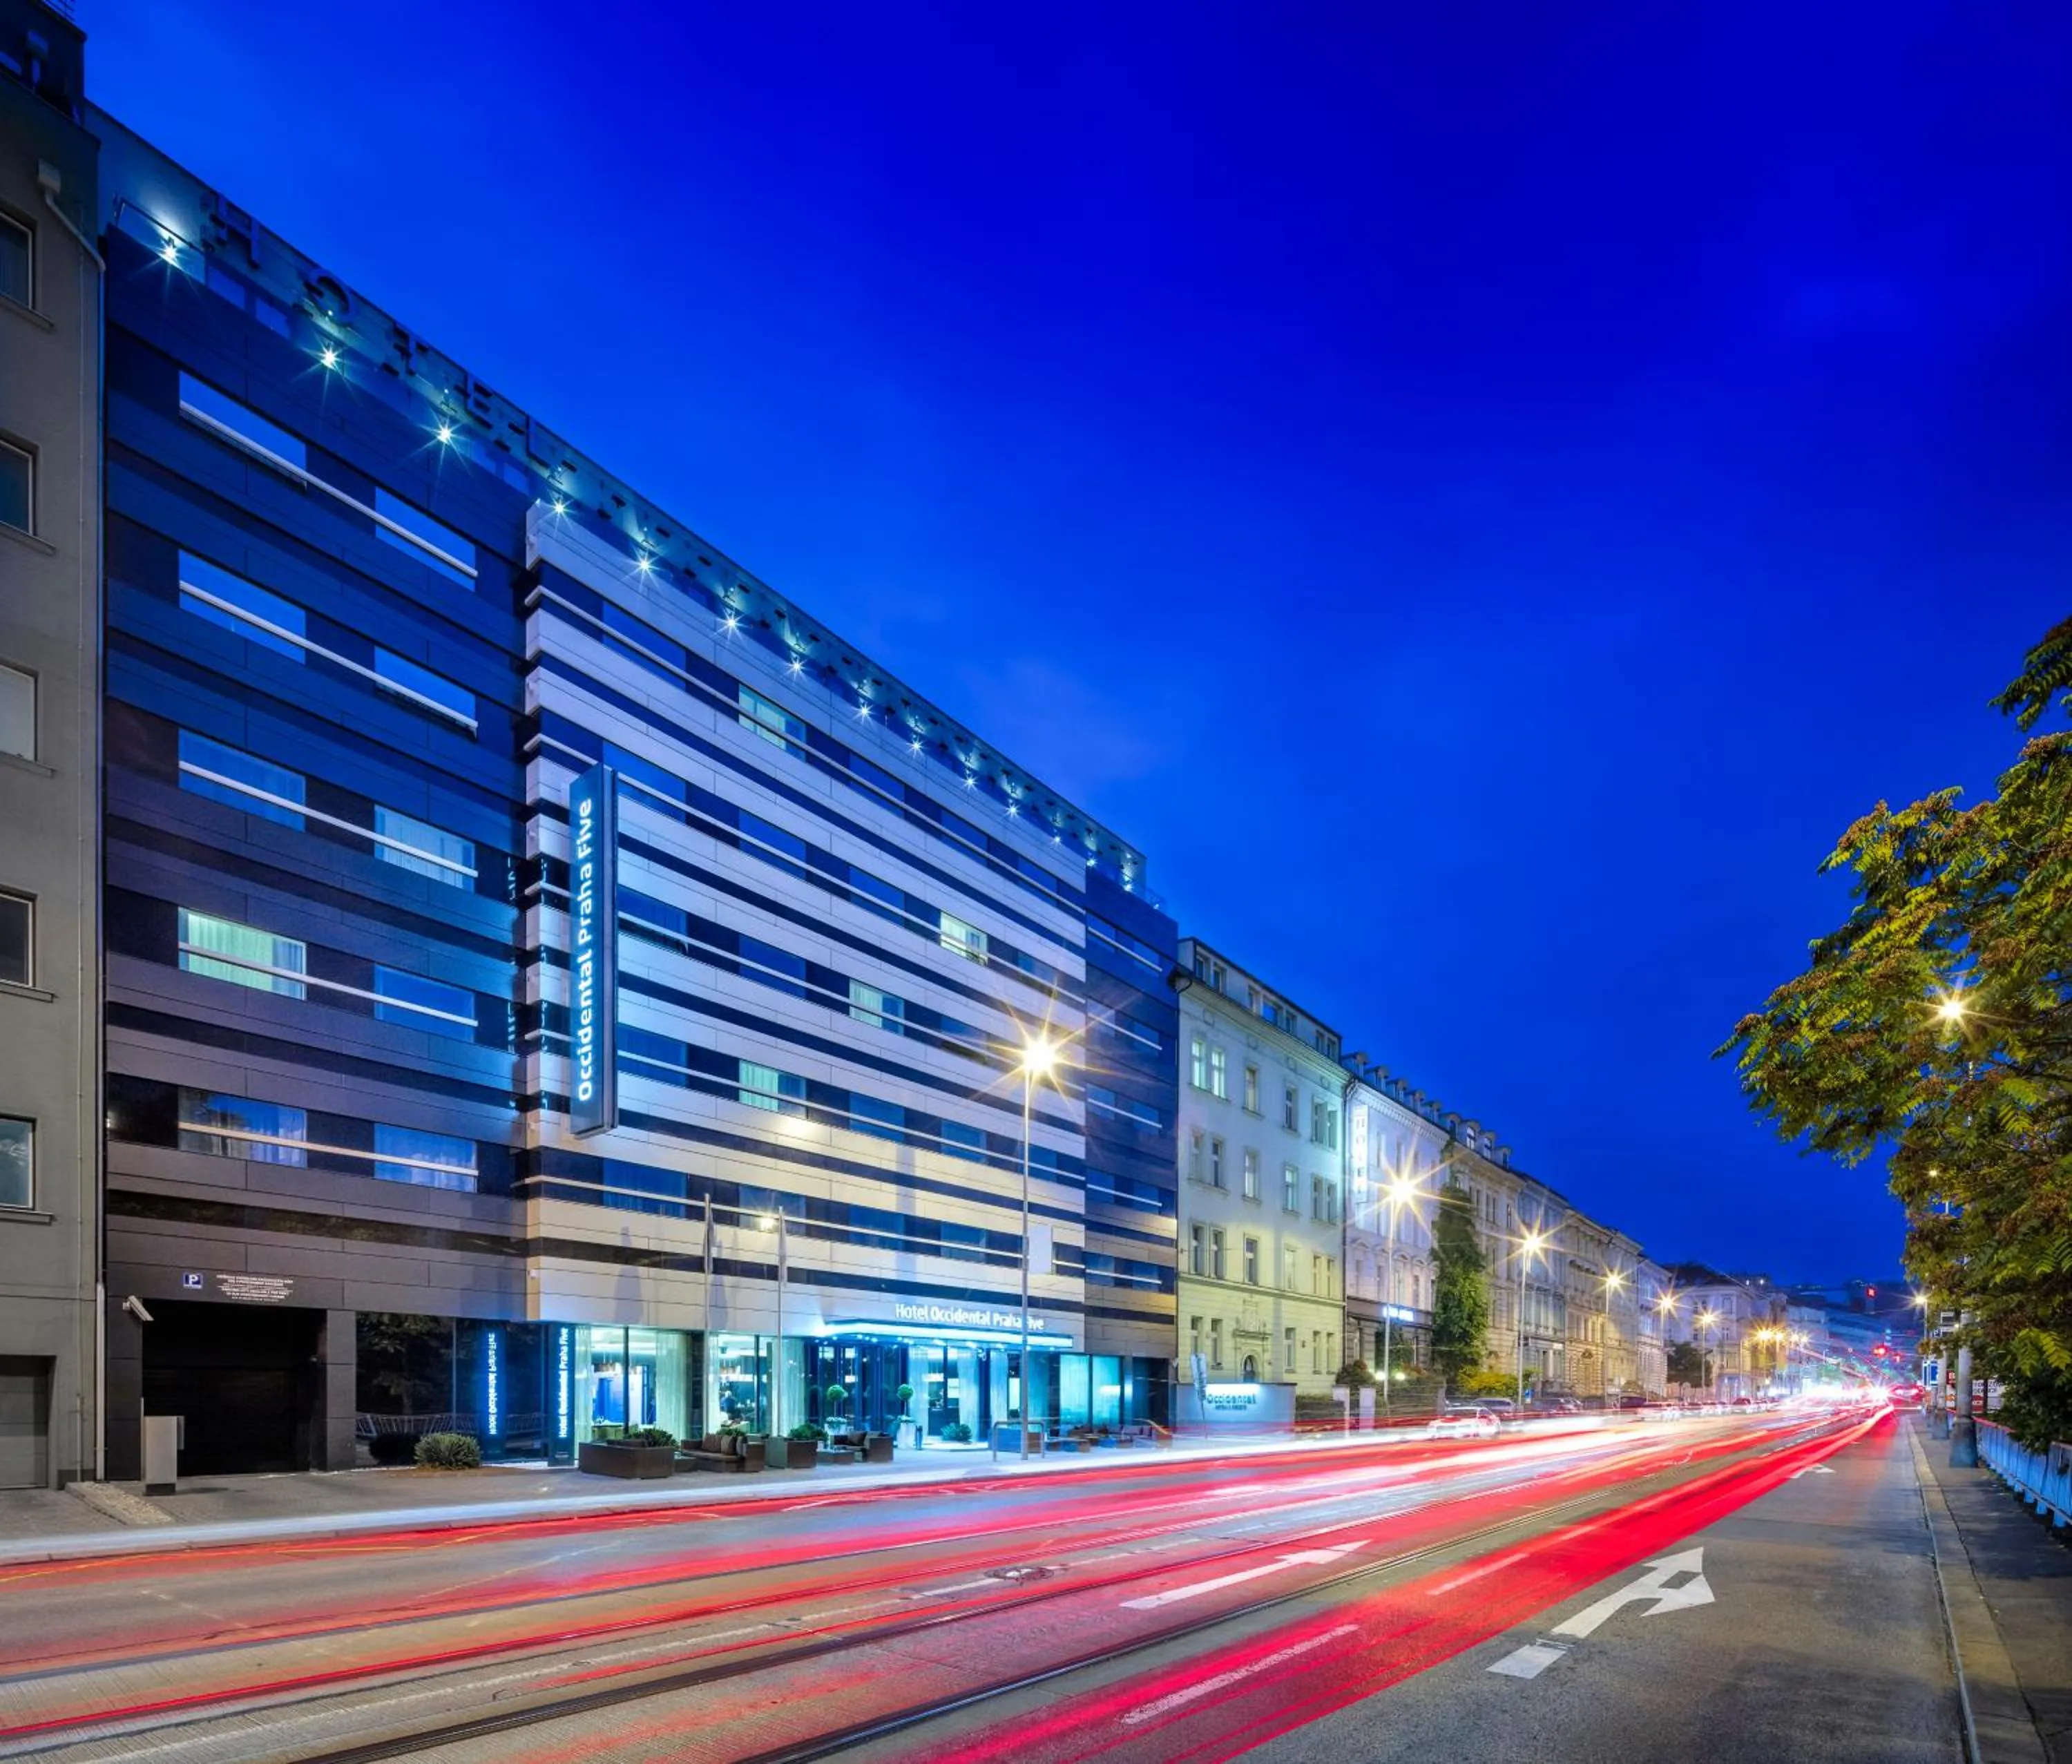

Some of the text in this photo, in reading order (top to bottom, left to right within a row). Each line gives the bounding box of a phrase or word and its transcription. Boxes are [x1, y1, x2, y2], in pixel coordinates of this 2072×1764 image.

[577, 798, 592, 1101] Occidental Praha Five
[189, 1274, 198, 1284] P
[896, 1303, 928, 1320] Hotel
[930, 1306, 990, 1326] Occidental
[993, 1312, 1022, 1328] Praha
[559, 1327, 568, 1345] Five
[559, 1346, 568, 1370] Praha
[559, 1415, 568, 1437] Hotel
